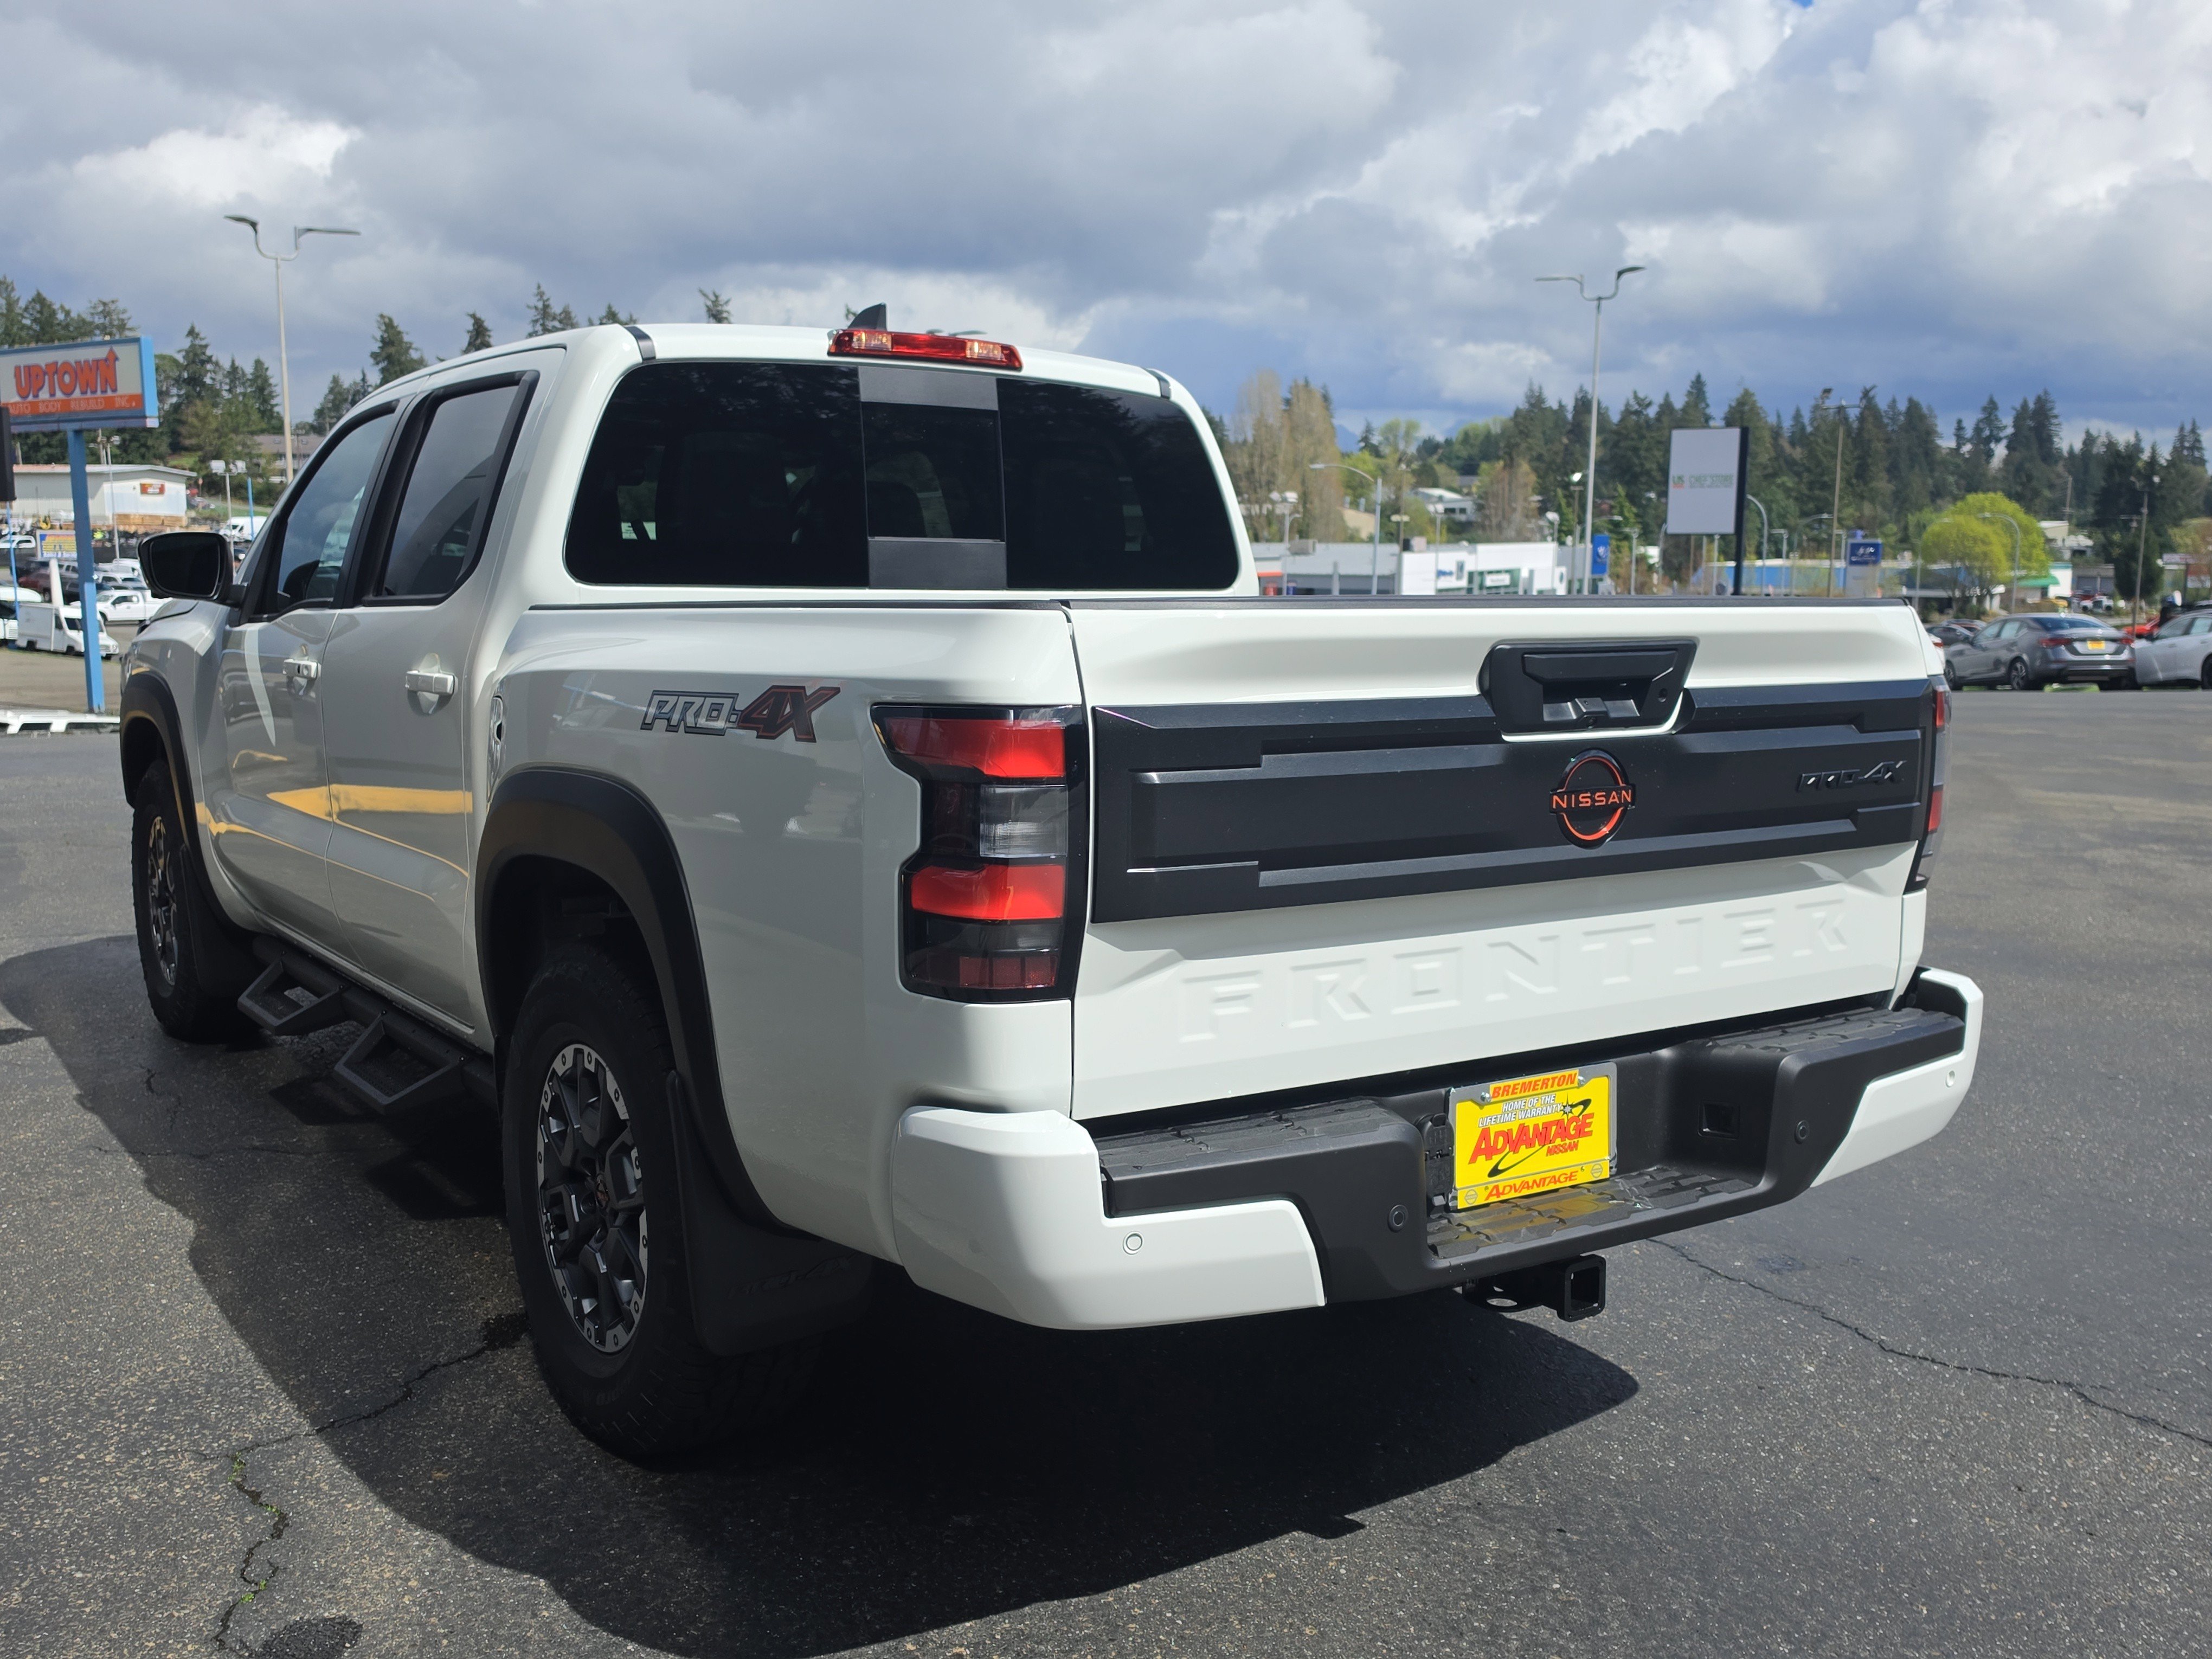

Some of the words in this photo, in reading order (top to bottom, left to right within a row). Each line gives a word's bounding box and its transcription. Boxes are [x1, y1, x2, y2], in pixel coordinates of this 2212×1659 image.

[14, 347, 119, 399] UPTOWN
[38, 401, 62, 413] BODY
[70, 397, 105, 411] REBUILD
[1552, 789, 1631, 809] NISSAN
[1179, 898, 1847, 1043] FRONTIER
[1491, 1072, 1577, 1099] BREMERTON
[1478, 1111, 1517, 1128] LIFETIME
[1518, 1103, 1563, 1121] WARRANTY
[1502, 1099, 1526, 1113] HOME
[1528, 1096, 1539, 1108] OF
[1541, 1094, 1556, 1105] THE
[1468, 1113, 1595, 1165] ADVANTAGE
[1546, 1141, 1579, 1157] NISSAN
[1484, 1171, 1579, 1201] ADVANTAGE
